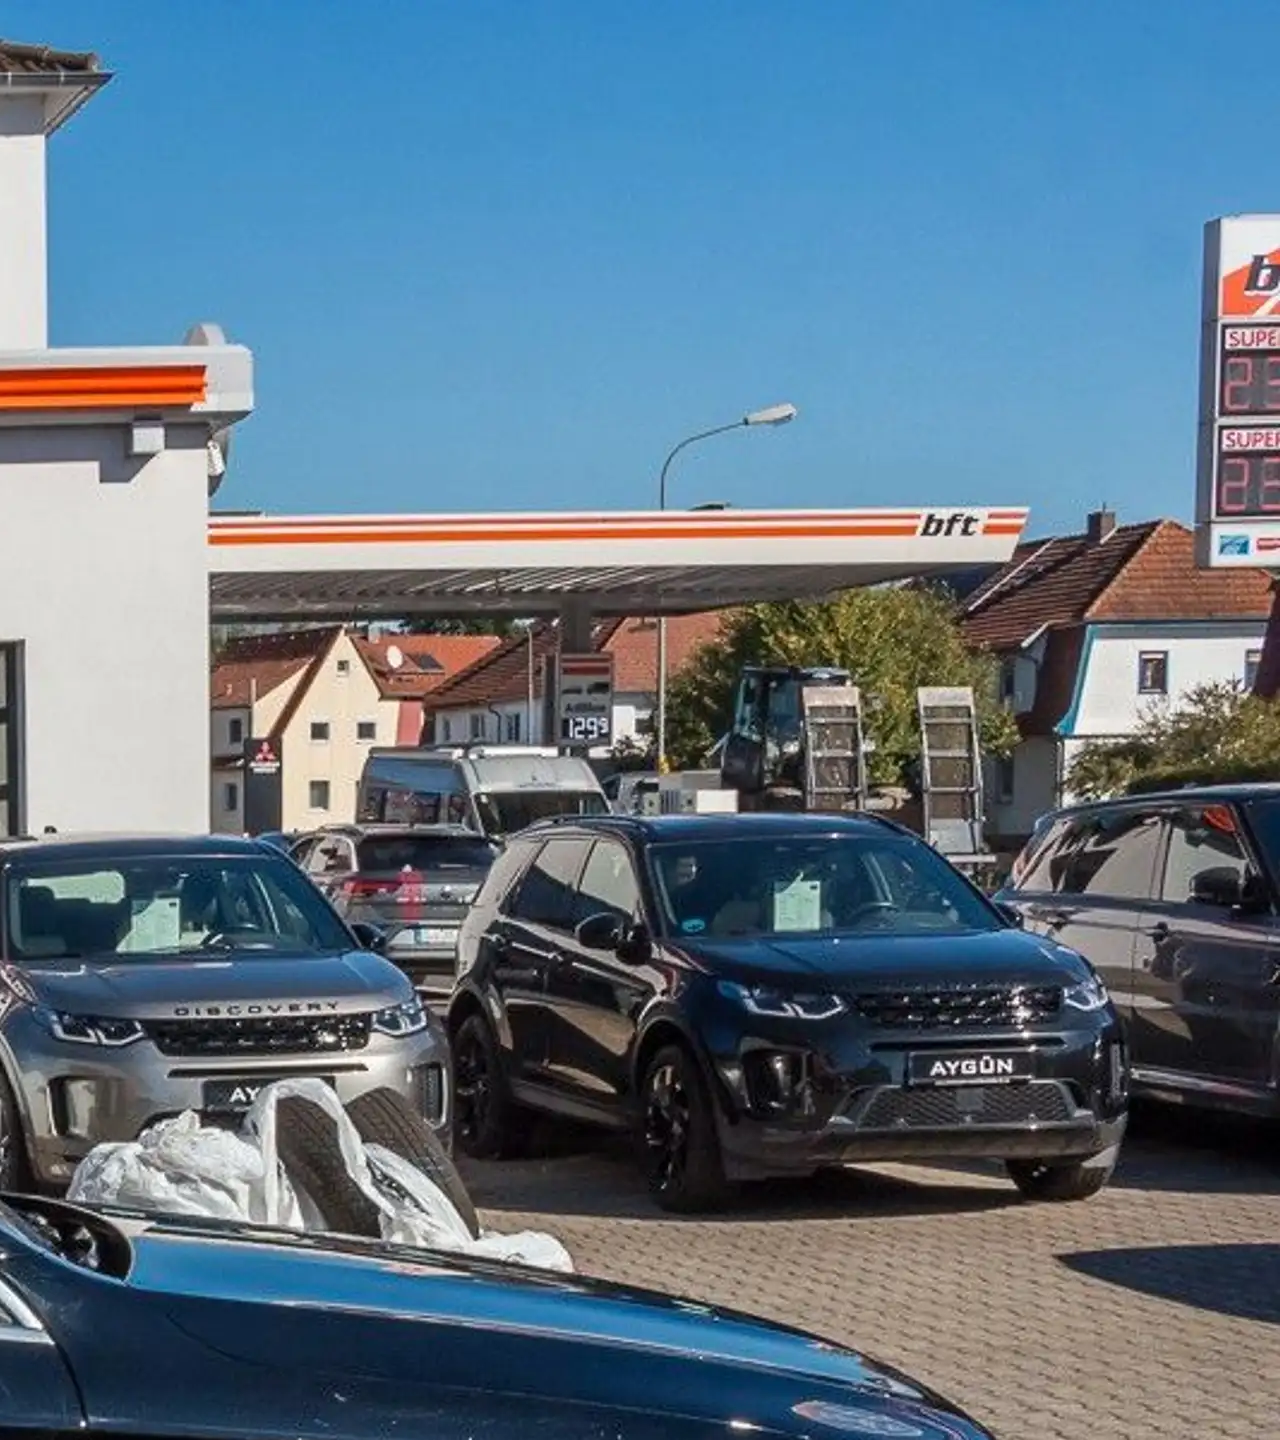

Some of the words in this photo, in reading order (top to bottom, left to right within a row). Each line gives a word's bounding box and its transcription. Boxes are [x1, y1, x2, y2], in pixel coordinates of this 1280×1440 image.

[920, 513, 980, 537] bft
[173, 1000, 341, 1017] DISCOVERY
[929, 1055, 1014, 1077] AYGÜN
